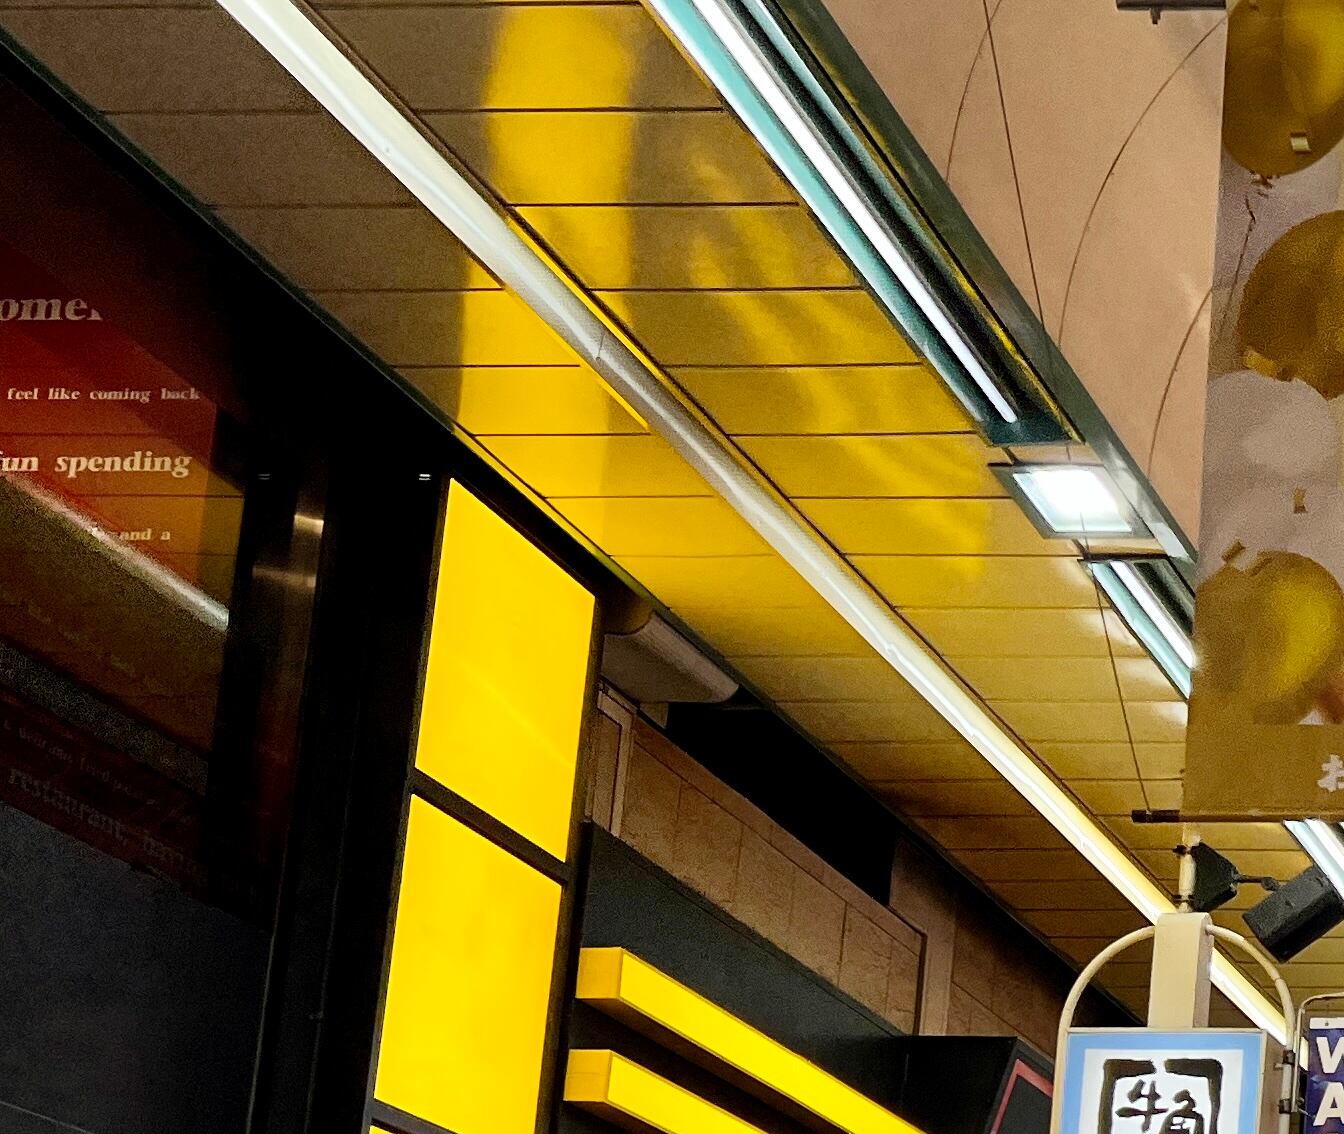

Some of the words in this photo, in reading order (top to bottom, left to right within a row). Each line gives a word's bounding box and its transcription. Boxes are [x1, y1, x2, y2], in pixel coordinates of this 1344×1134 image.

[7, 387, 39, 401] feel
[48, 386, 81, 401] like
[89, 387, 152, 404] coming
[55, 451, 193, 479] spending
